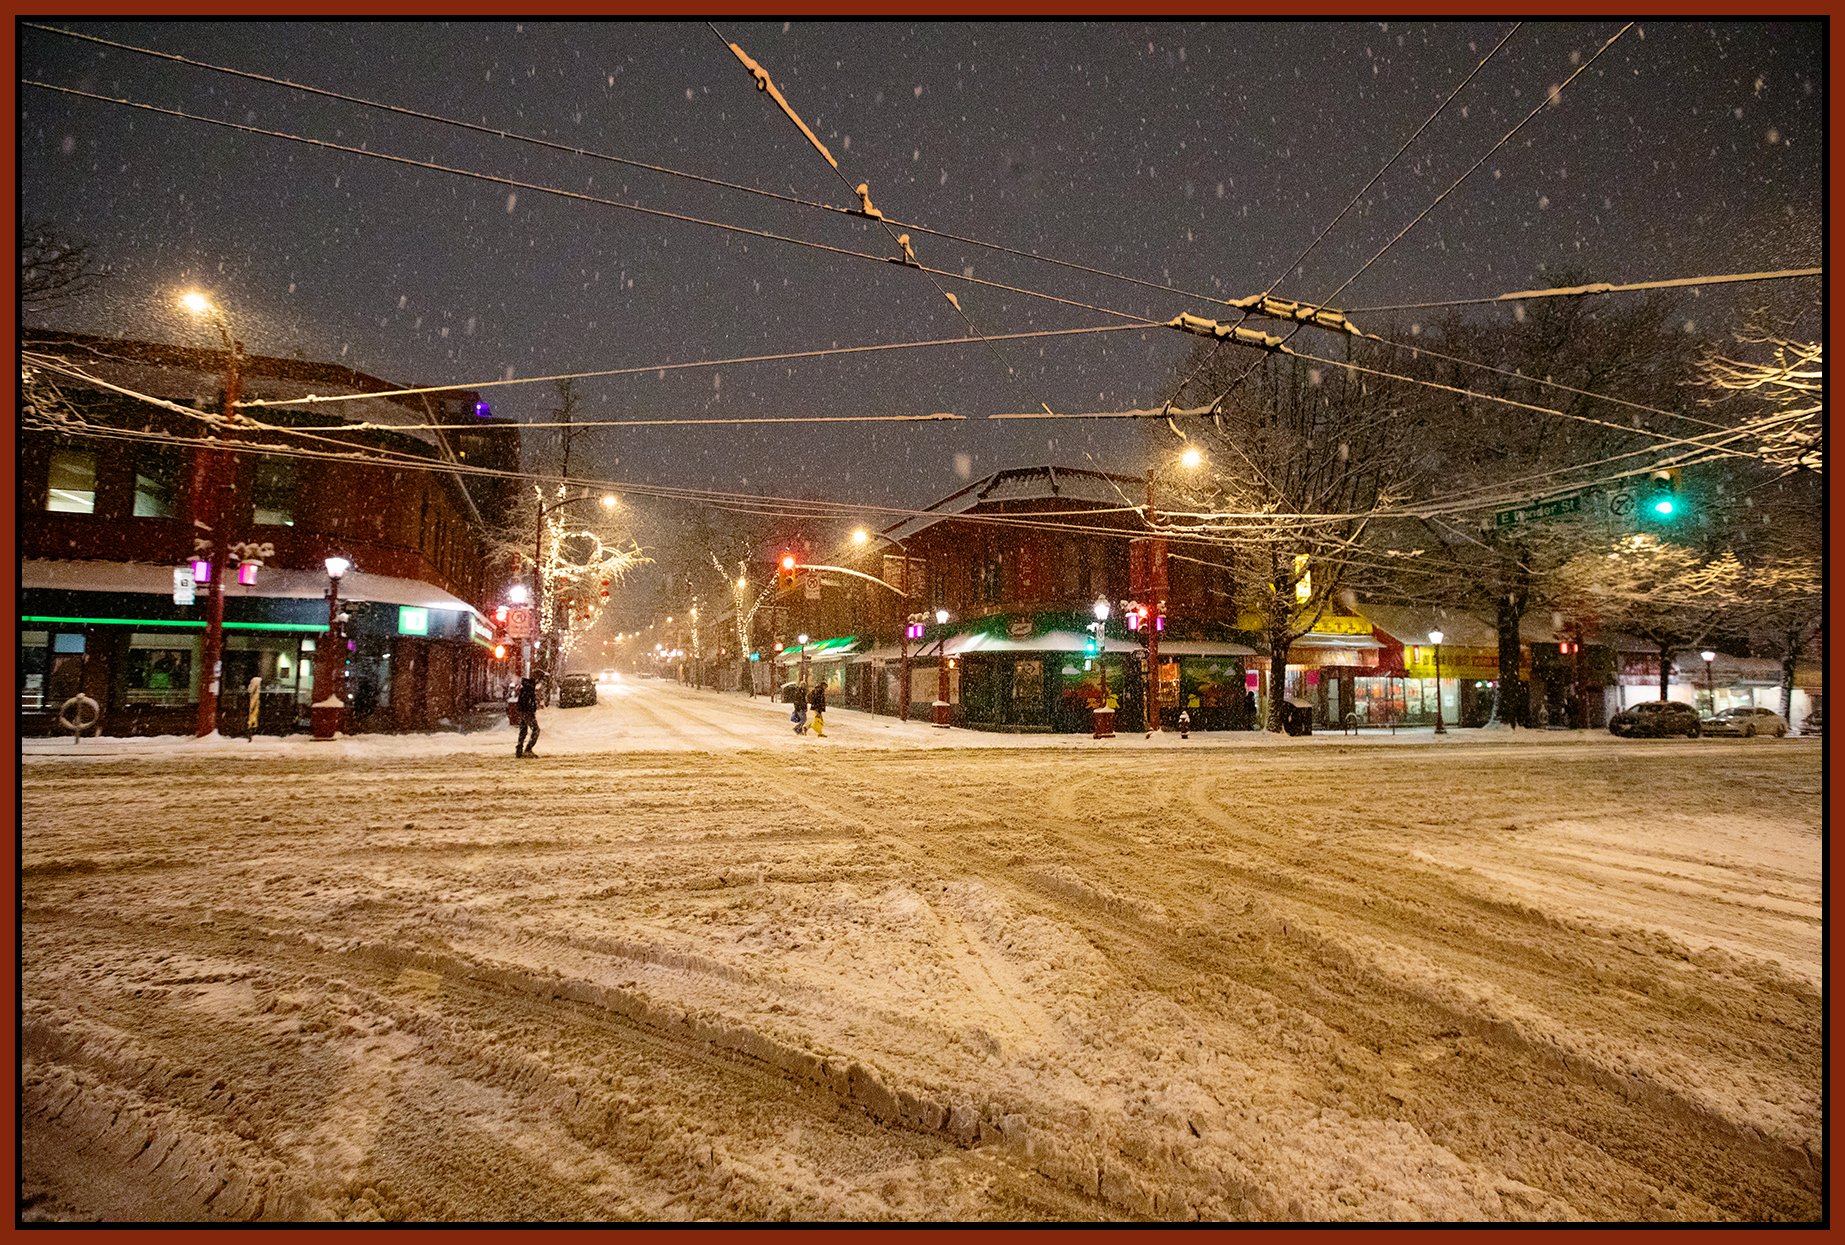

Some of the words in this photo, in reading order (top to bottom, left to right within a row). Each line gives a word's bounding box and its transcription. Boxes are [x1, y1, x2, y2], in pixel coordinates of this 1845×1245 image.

[1501, 513, 1509, 523] E
[1561, 500, 1575, 512] St
[401, 611, 425, 630] TD
